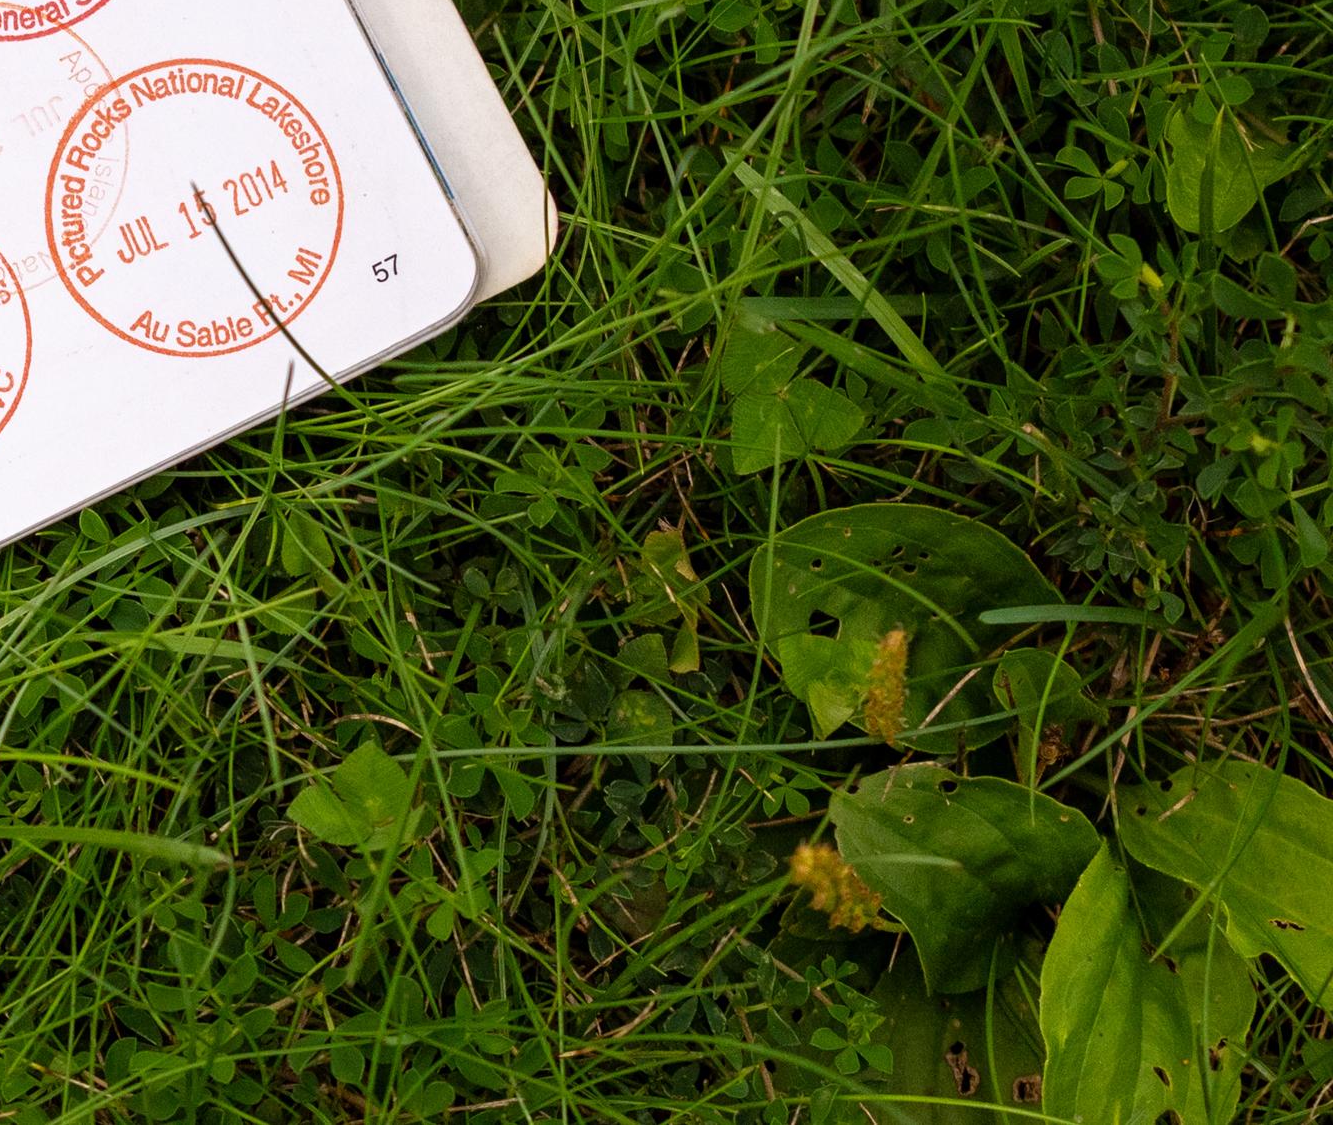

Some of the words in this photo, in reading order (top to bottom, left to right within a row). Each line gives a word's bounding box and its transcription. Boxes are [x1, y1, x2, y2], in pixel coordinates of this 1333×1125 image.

[66, 97, 132, 172] Rocks
[129, 68, 245, 107] National
[246, 82, 330, 206] Lakeshore
[61, 174, 105, 287] Pictured
[117, 215, 169, 264] JUL
[223, 160, 288, 216] 2014
[130, 310, 169, 343] Au
[176, 316, 254, 347] Sable
[288, 247, 322, 285] MI
[371, 254, 399, 283] 57
